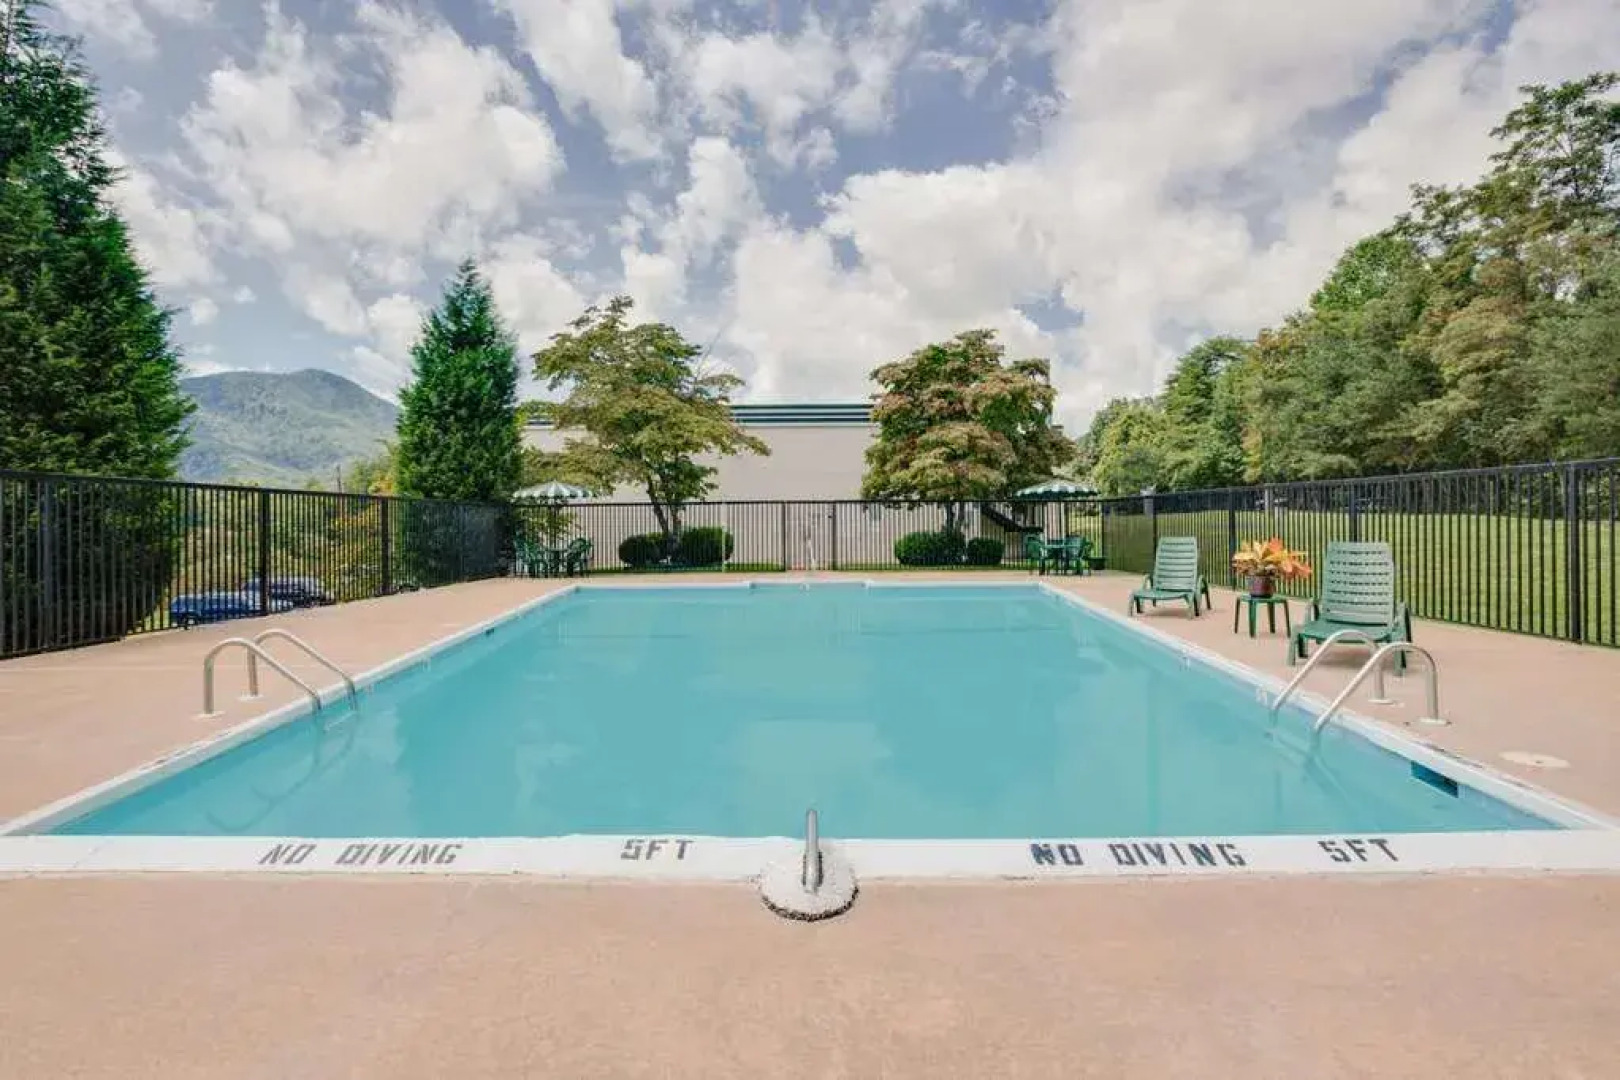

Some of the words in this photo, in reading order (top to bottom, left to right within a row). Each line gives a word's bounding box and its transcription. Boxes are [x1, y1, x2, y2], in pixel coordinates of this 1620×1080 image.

[258, 844, 316, 865] NO
[335, 844, 462, 866] DIVING
[620, 838, 695, 861] 5FT
[1030, 843, 1084, 866] NO
[1107, 843, 1247, 867] DIVING
[1317, 838, 1399, 863] 5FT
